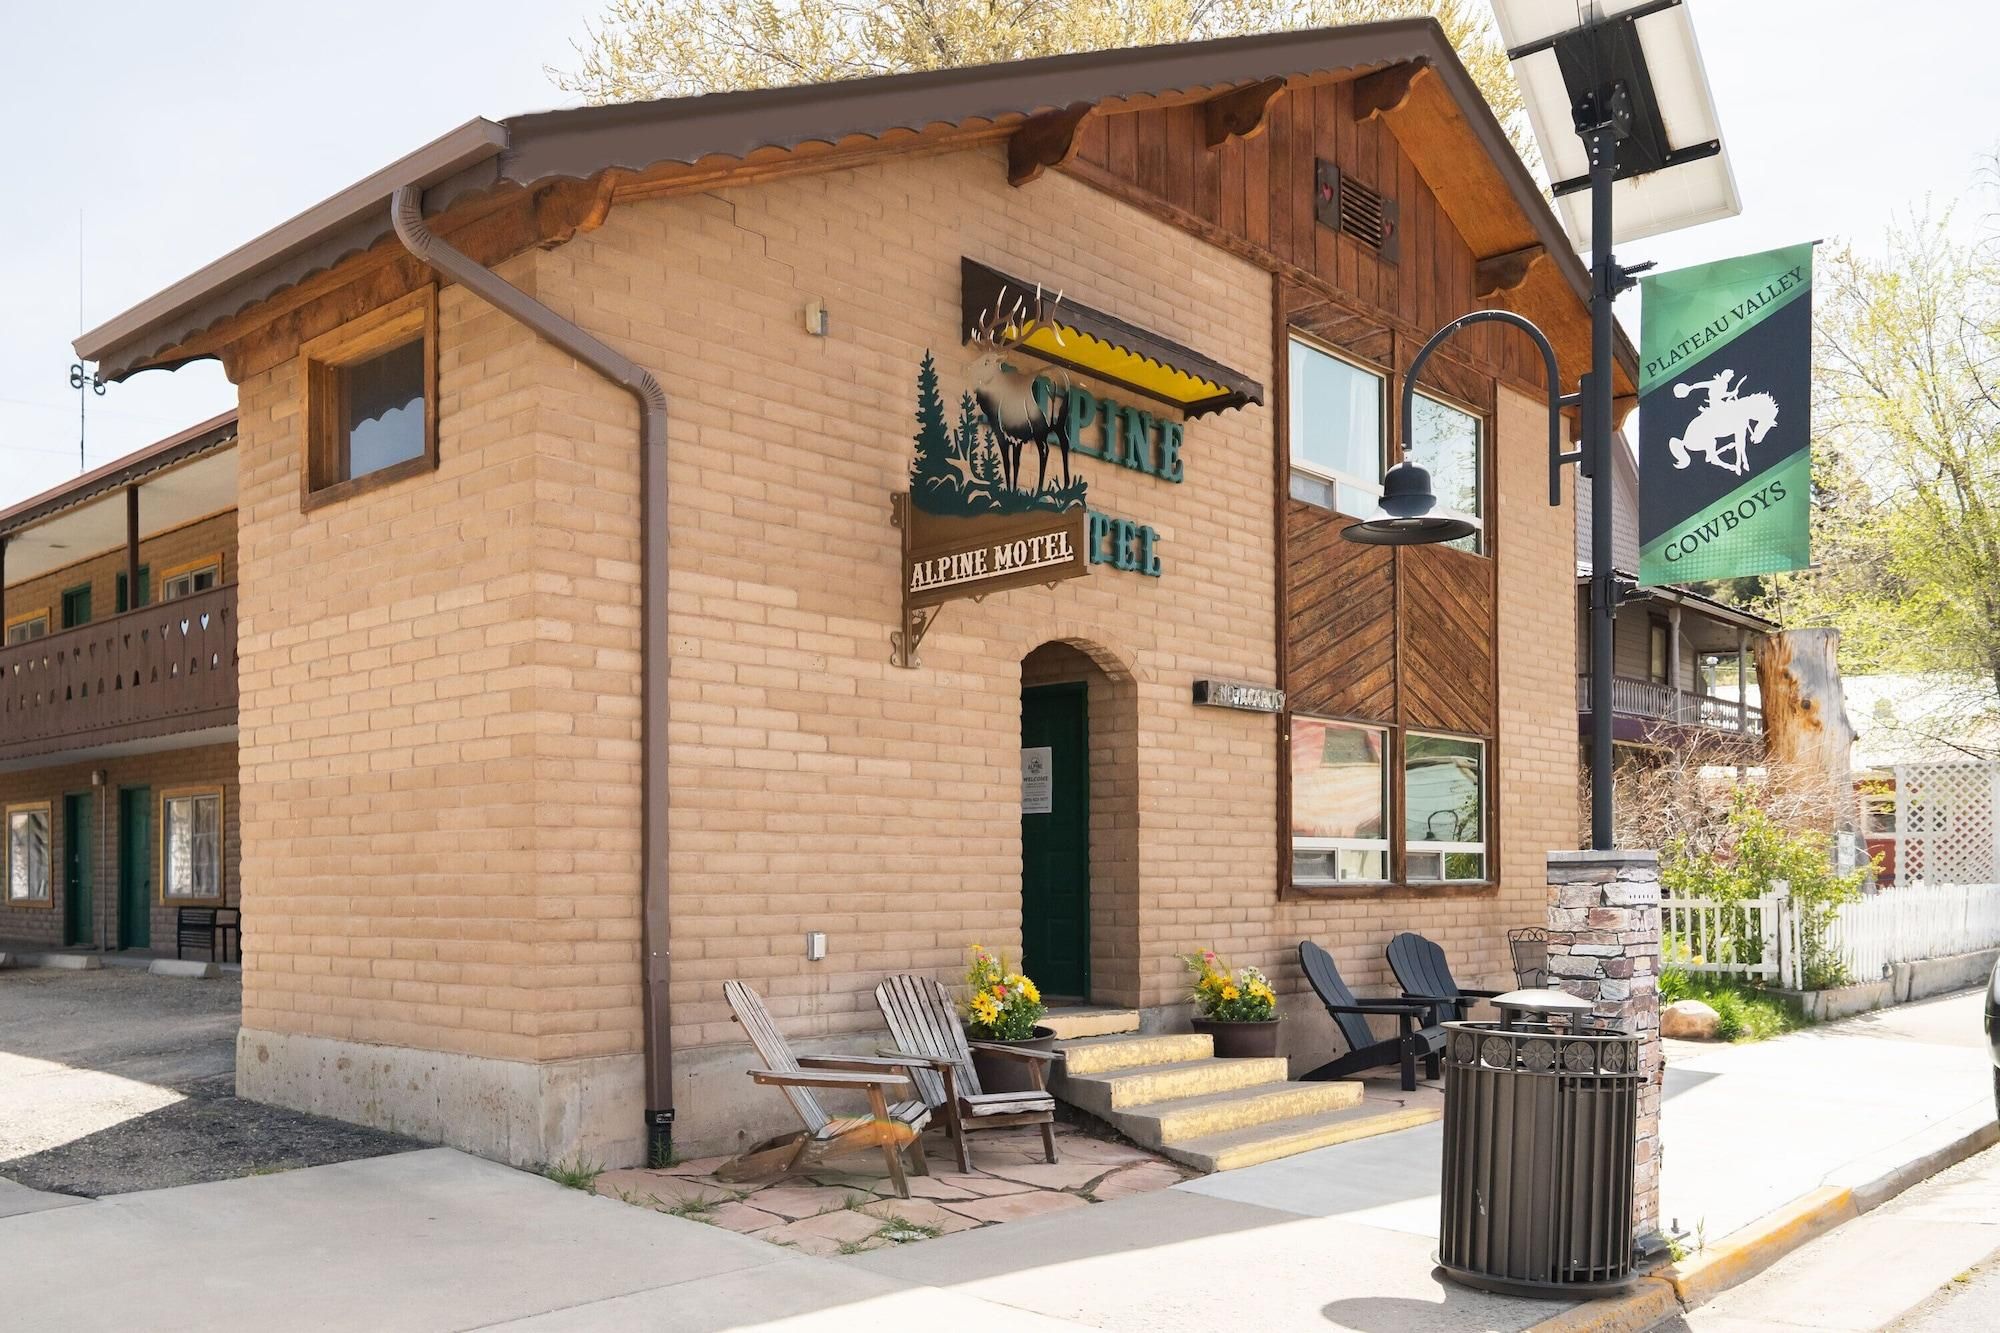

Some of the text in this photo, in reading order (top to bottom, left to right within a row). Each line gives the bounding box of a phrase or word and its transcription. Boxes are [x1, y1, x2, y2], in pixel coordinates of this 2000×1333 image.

[1645, 266, 1803, 377] PLATEAU VALLEY
[1088, 509, 1161, 577] TEL
[1664, 480, 1787, 562] COWBOYS
[911, 531, 1074, 588] ALPINE MOTEL
